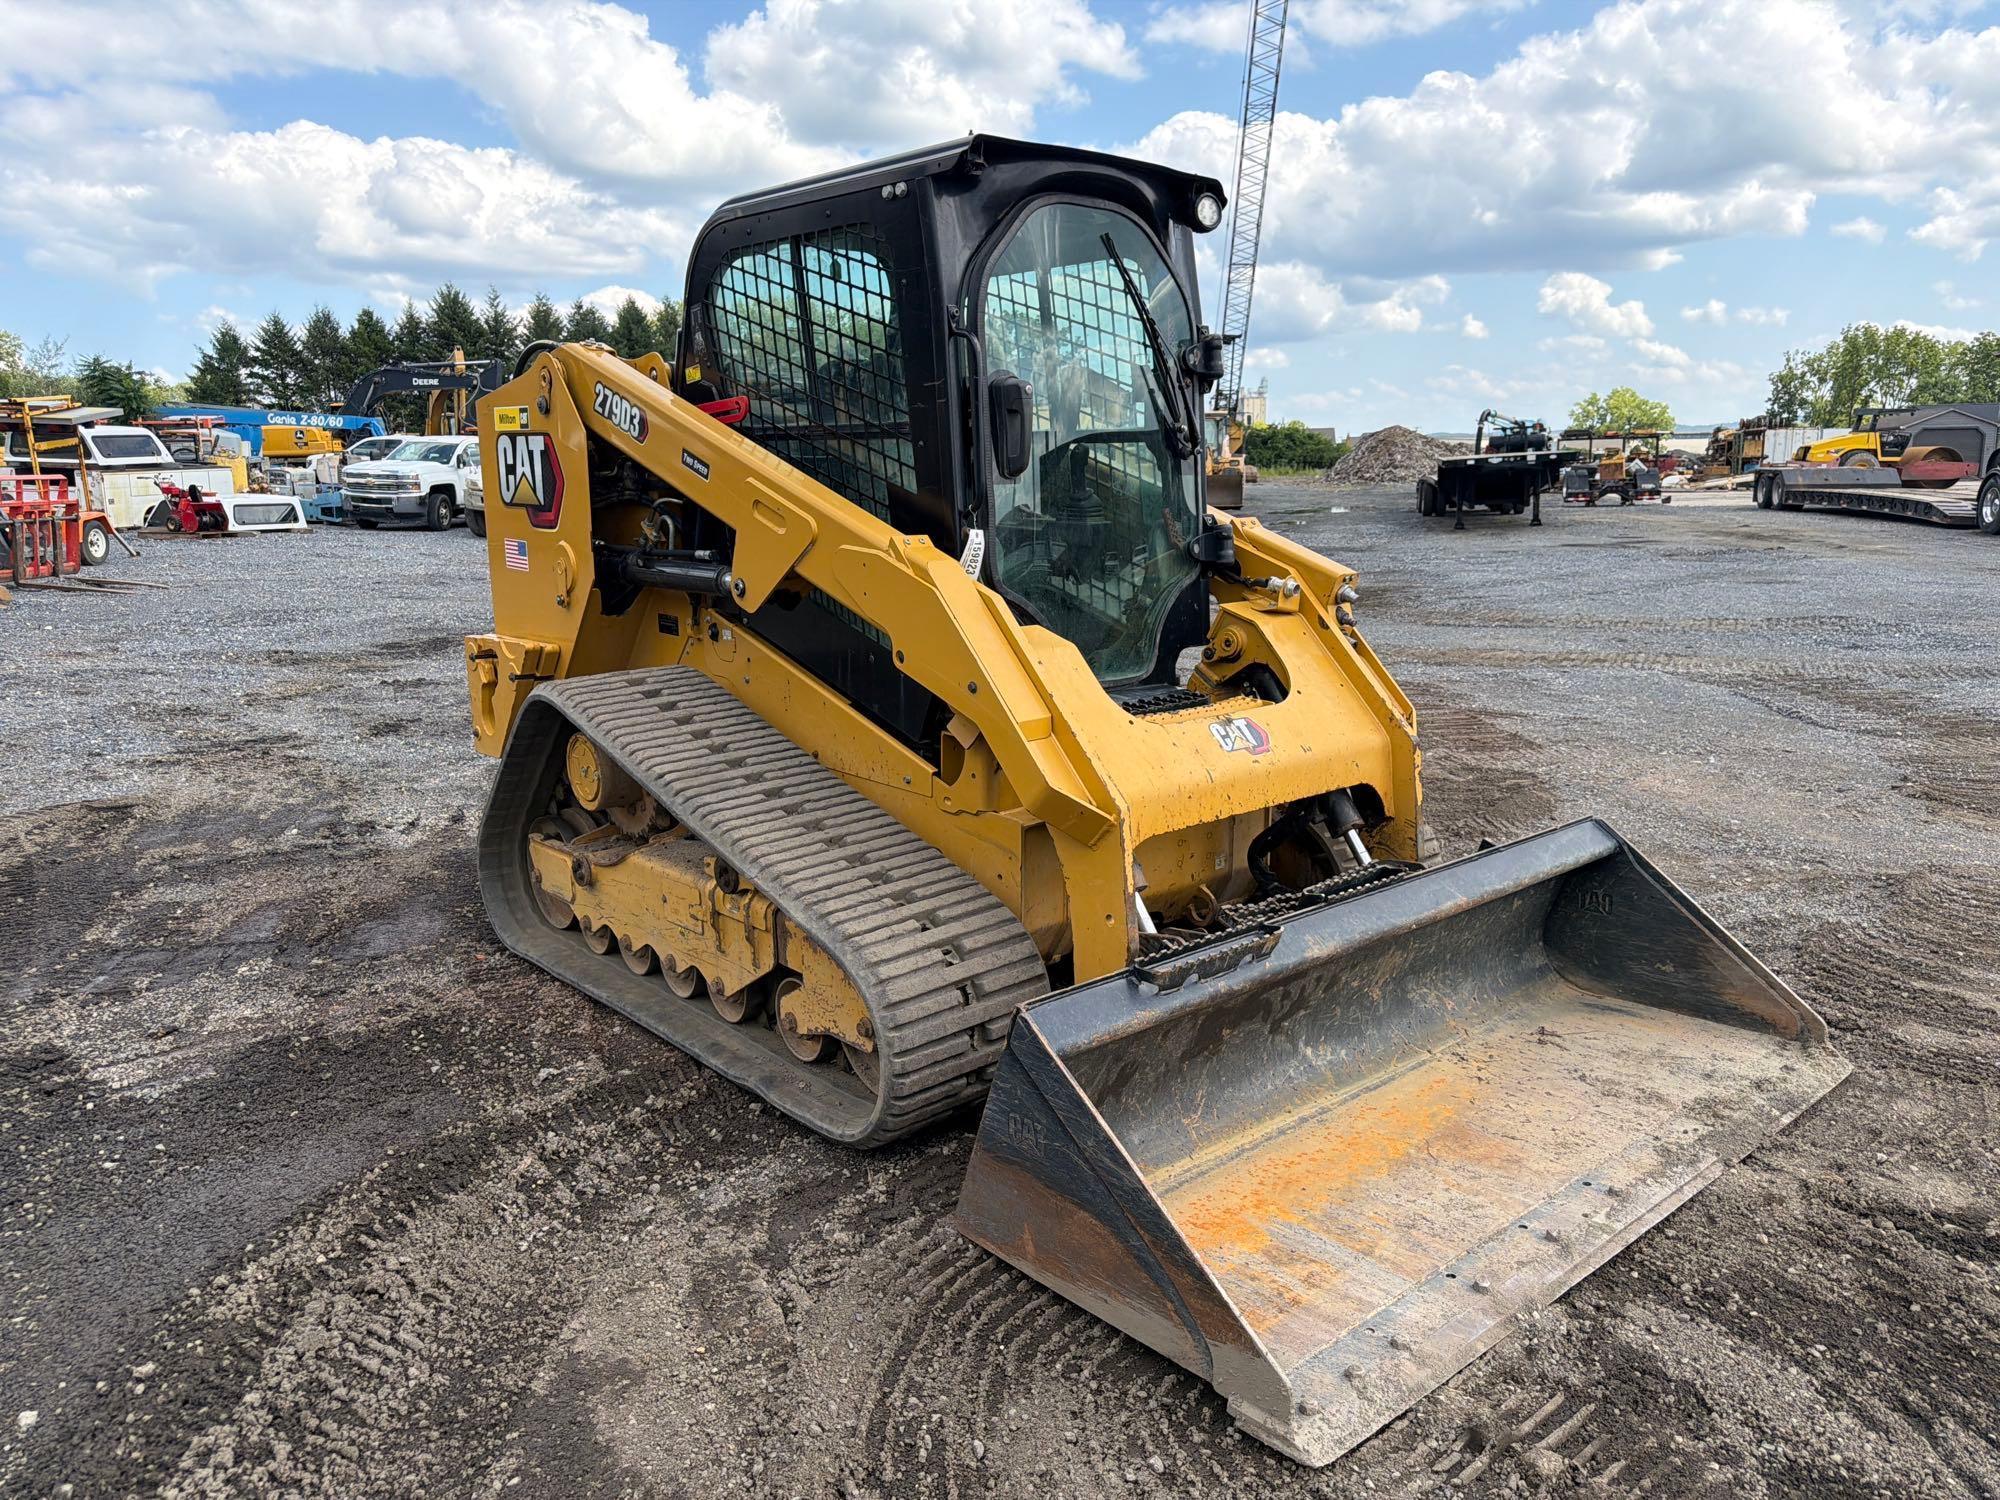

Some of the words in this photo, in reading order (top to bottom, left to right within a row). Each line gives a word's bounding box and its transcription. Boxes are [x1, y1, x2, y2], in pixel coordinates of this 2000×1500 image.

[412, 377, 440, 386] DEERE
[267, 412, 297, 425] Genie
[300, 414, 344, 428] Z-80/60
[498, 413, 517, 425] Milton
[594, 382, 640, 438] 279D3
[497, 434, 545, 506] CAT
[965, 541, 982, 575] 159823
[1209, 718, 1259, 752] CAT
[1008, 1112, 1047, 1156] CAT
